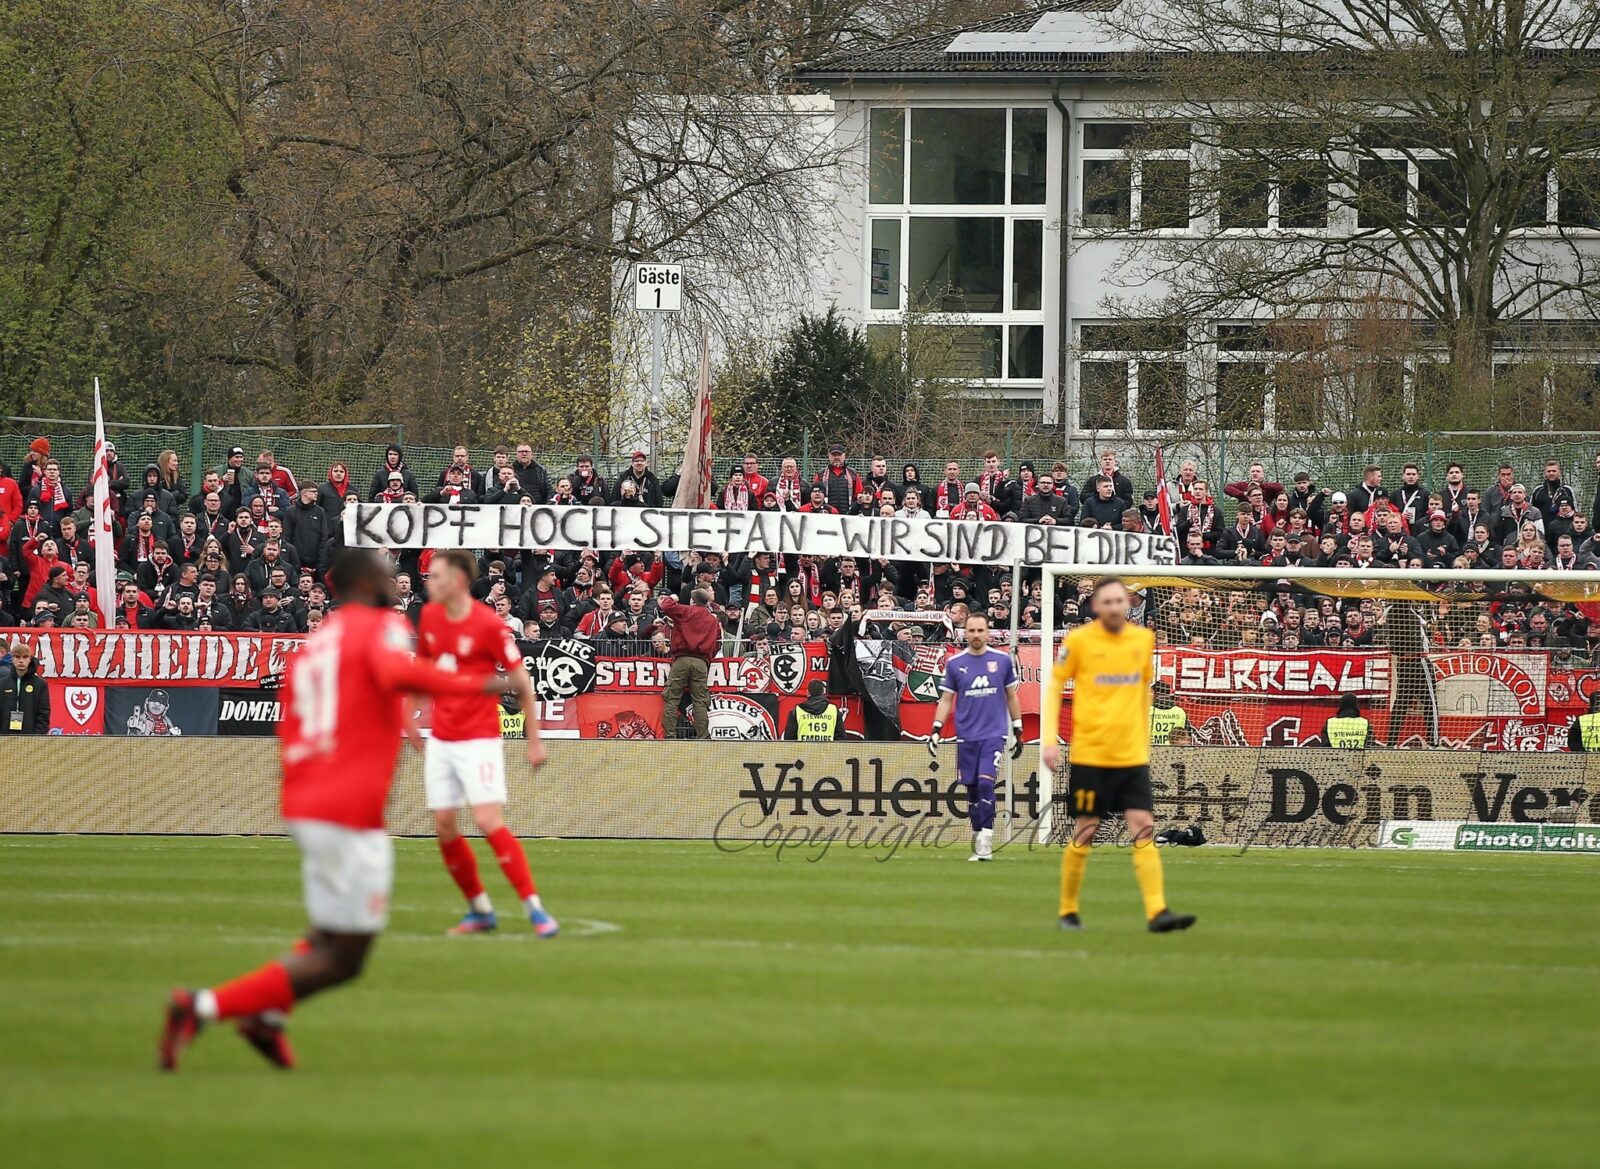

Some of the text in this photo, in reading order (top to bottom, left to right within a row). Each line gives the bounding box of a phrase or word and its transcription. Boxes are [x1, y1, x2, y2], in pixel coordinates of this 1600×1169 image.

[638, 266, 680, 285] Gäste
[654, 287, 661, 308] 1
[355, 504, 480, 546] KOPF
[500, 506, 617, 548] HOCH
[634, 508, 807, 552] STEFAN
[840, 517, 911, 556] WIR
[920, 522, 1008, 562] SIND
[1025, 525, 1080, 565] BEI
[1087, 531, 1143, 565] DIR
[559, 639, 592, 660] HFC
[770, 643, 795, 656] HFC
[595, 659, 748, 688] STENAL
[802, 713, 832, 721] STEWARD
[714, 728, 736, 738] HFC
[808, 723, 828, 732] 169
[1075, 788, 1096, 813] 11
[1265, 763, 1433, 825] Dein
[1460, 770, 1600, 823] Ver
[1459, 830, 1535, 848] Photo
